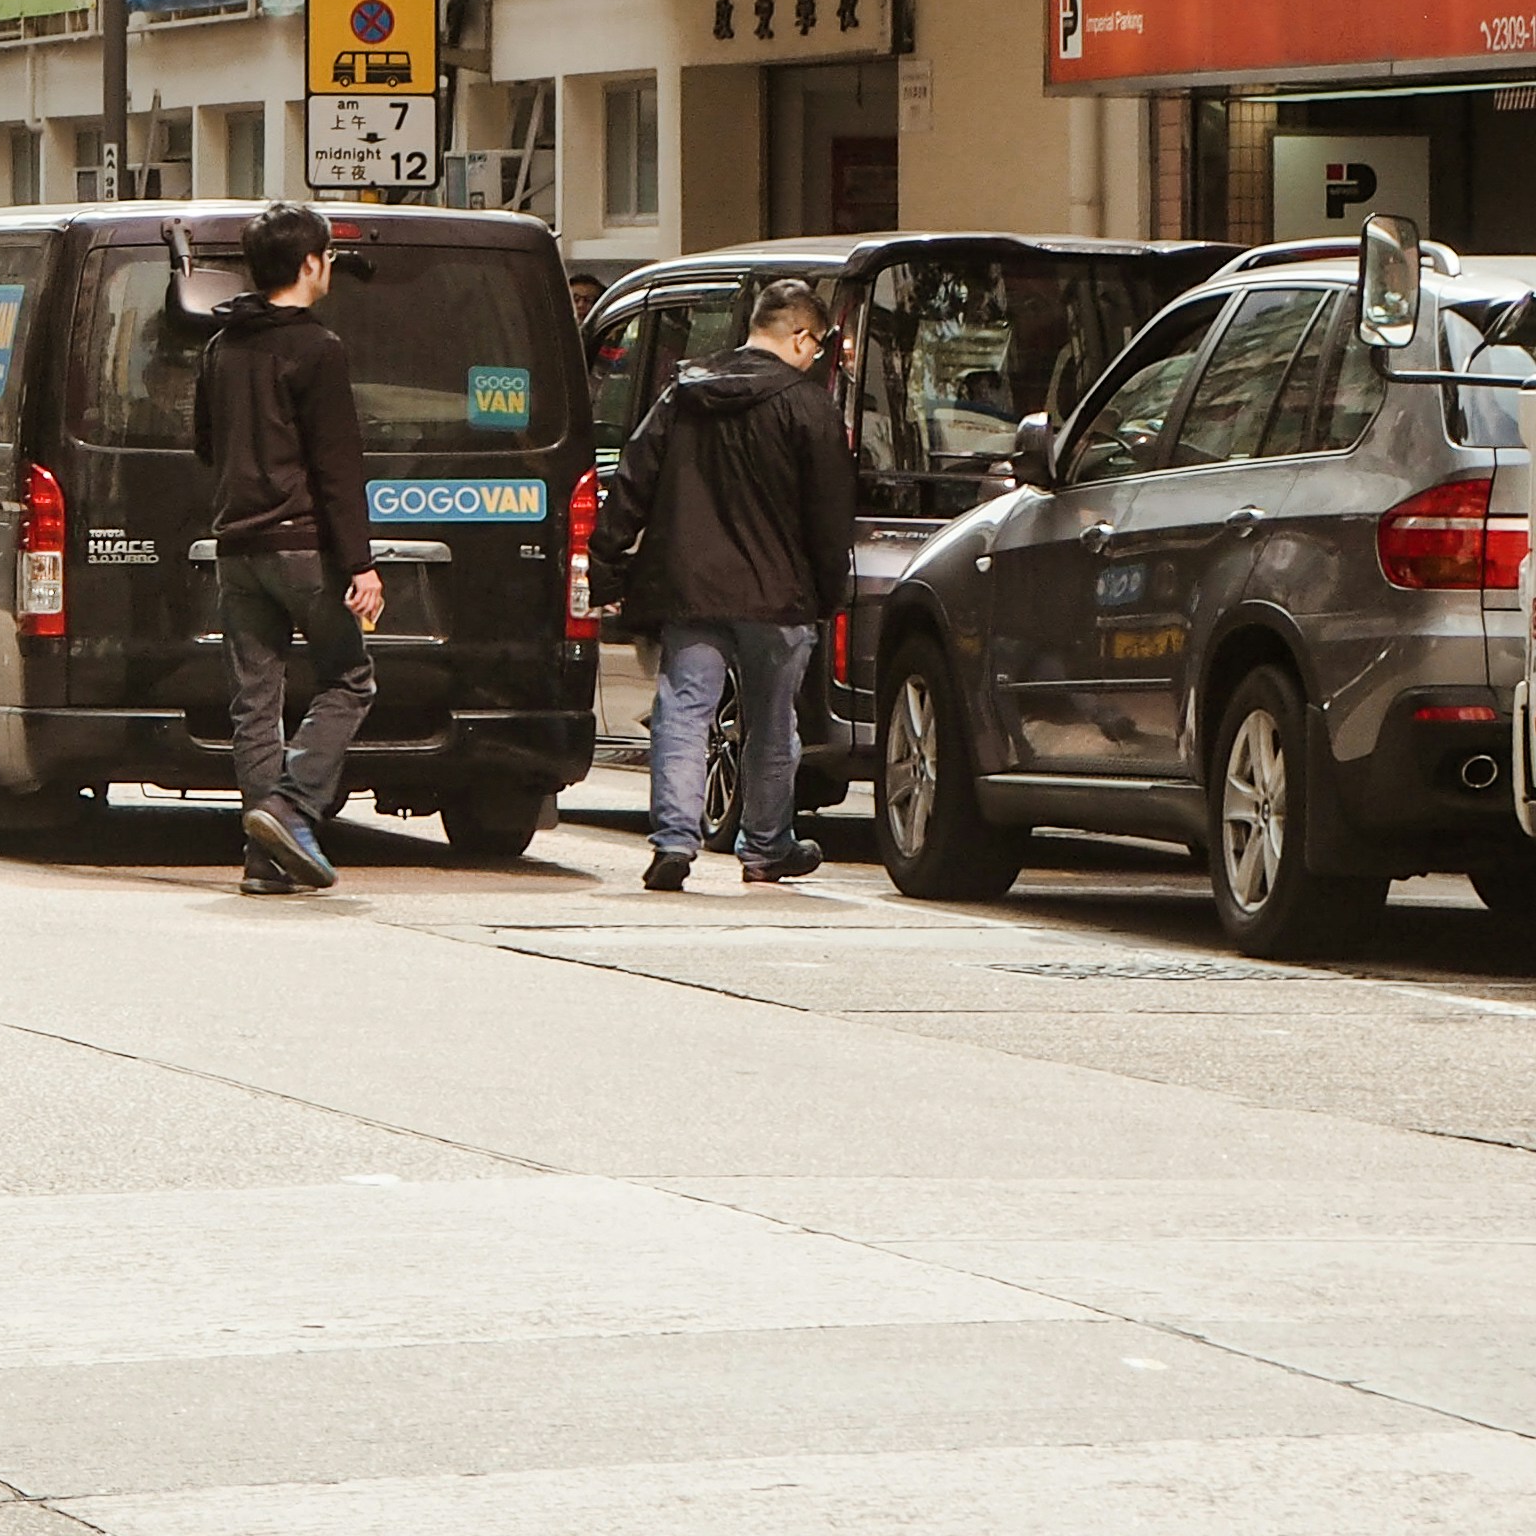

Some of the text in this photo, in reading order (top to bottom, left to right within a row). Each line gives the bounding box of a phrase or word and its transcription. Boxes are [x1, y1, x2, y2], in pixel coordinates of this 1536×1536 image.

[330, 114, 366, 131] 上午
[338, 99, 409, 131] am 7
[315, 147, 427, 181] midnight 12
[331, 164, 367, 181] 午夜
[474, 374, 525, 392] GOGO
[475, 391, 525, 414] VAN
[373, 485, 540, 515] GOGOVAN
[88, 528, 127, 538] TOYOTA
[88, 539, 155, 554] HIACE
